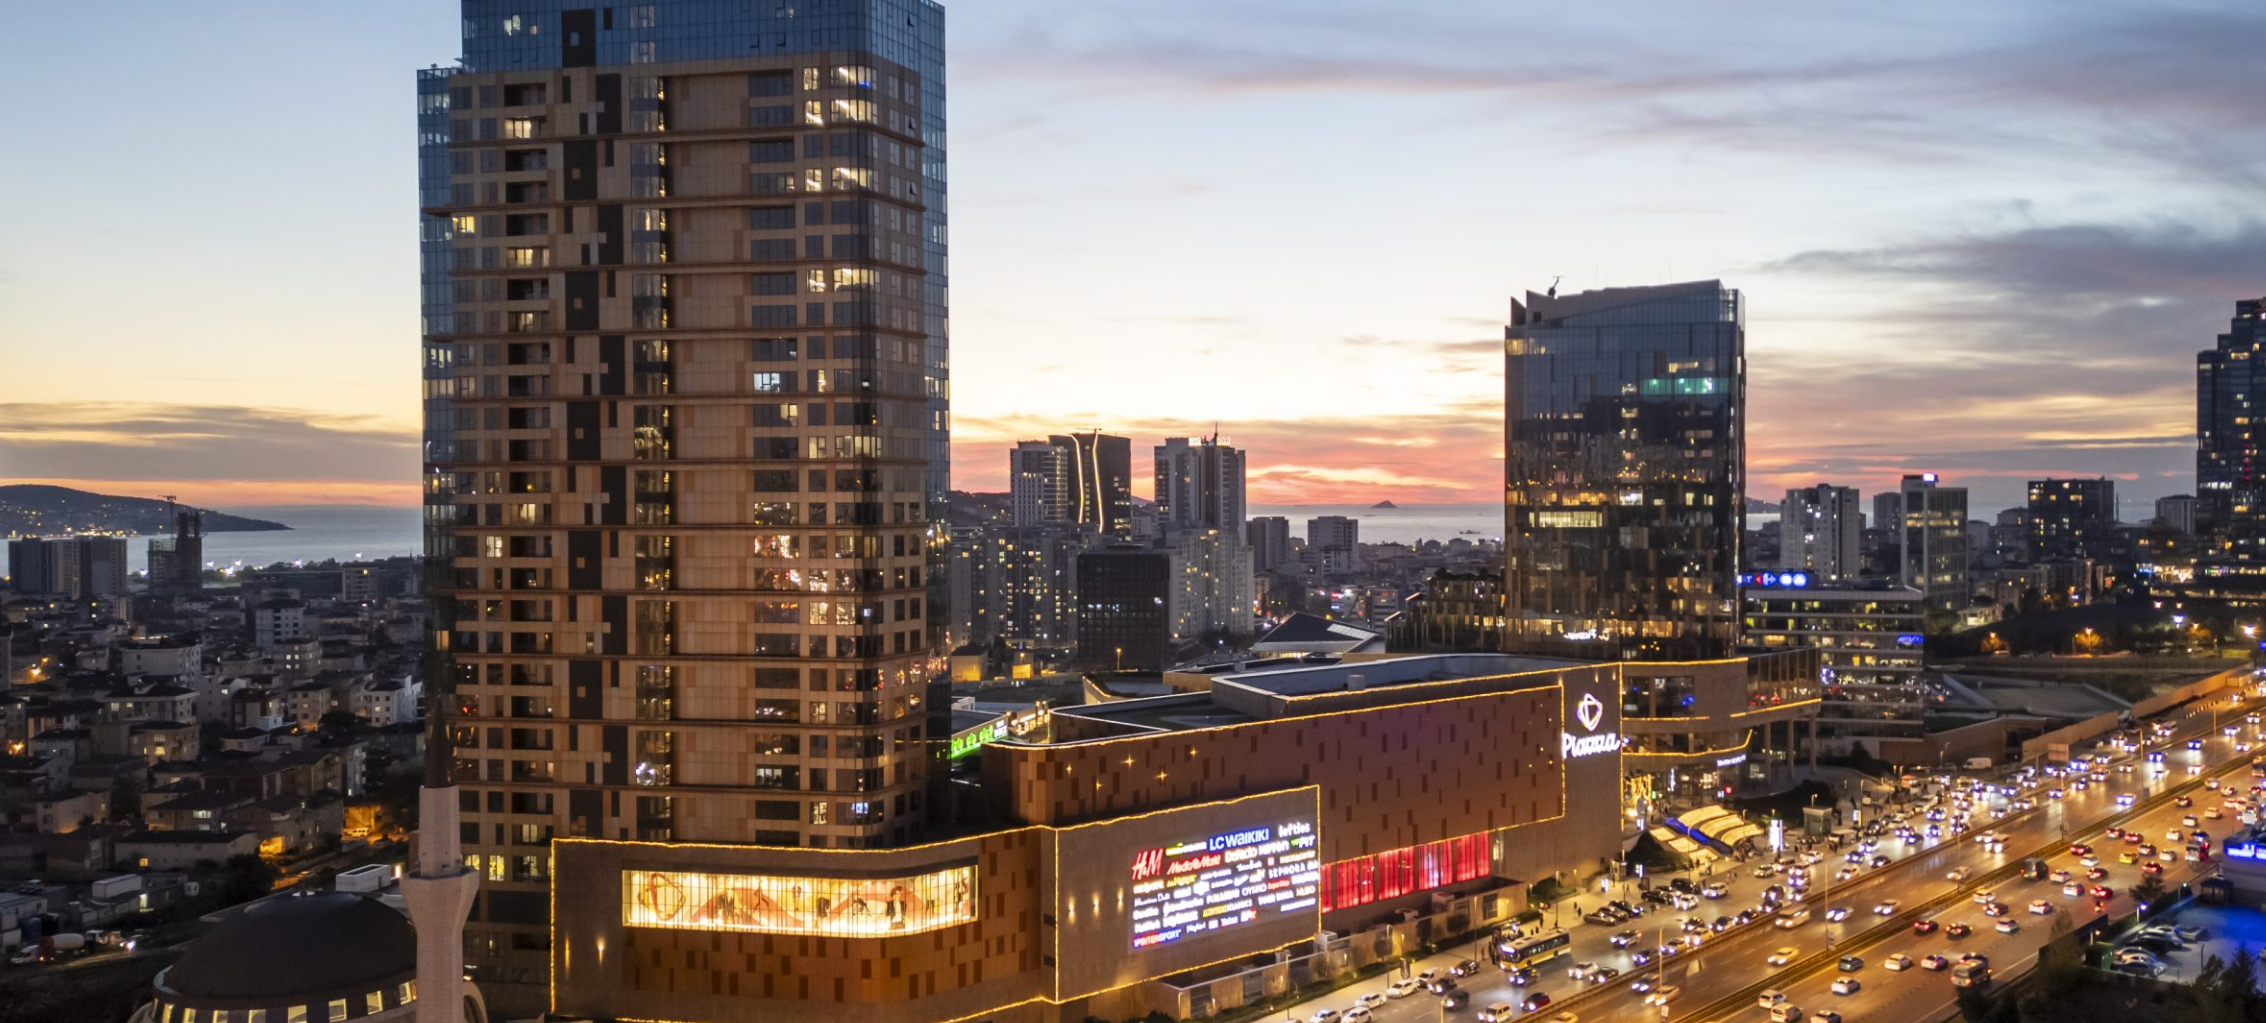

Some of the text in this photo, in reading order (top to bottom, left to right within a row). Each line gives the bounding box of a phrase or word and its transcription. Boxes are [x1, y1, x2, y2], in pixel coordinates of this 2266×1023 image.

[1562, 732, 1620, 759] Piazza
[1209, 836, 1225, 851] LC
[1131, 848, 1163, 880] H&M
[1268, 862, 1306, 878] SEPHORA
